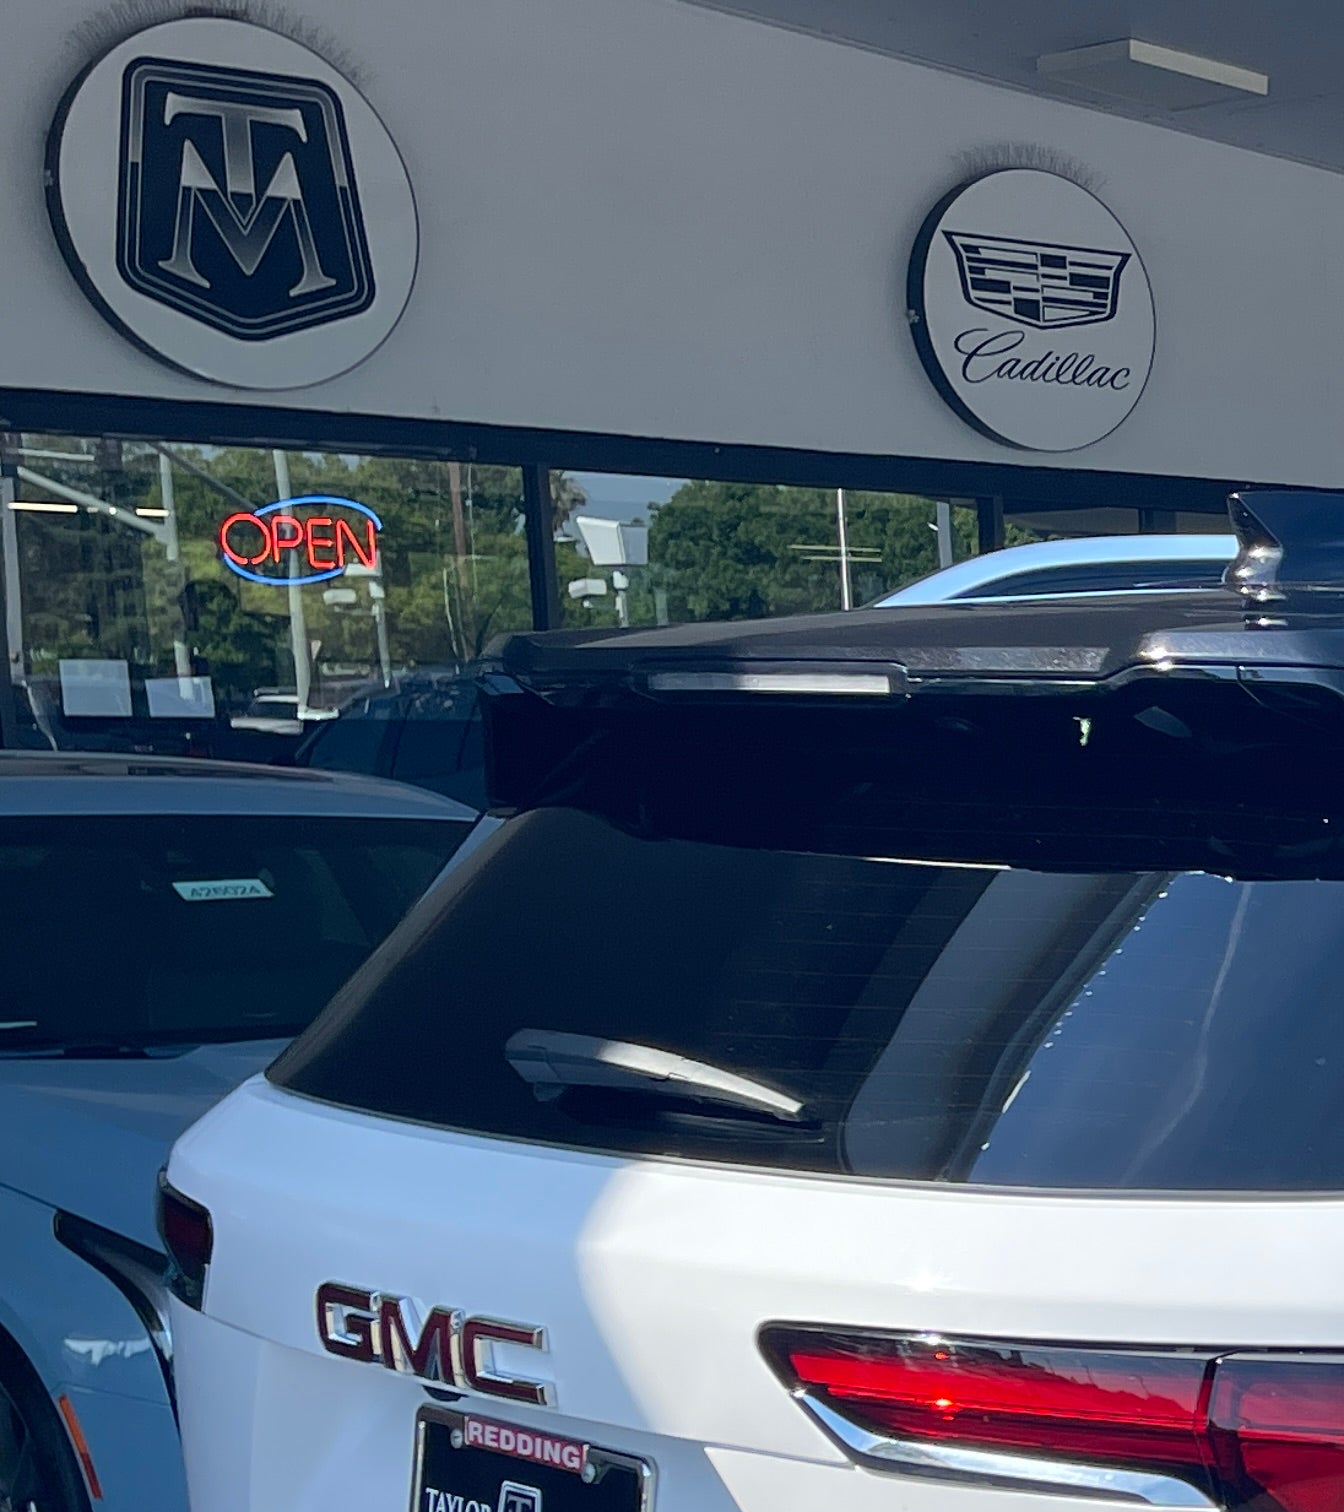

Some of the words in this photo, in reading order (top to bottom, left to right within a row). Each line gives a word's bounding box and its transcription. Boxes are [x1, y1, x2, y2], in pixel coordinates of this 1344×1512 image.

[953, 328, 1131, 391] Cadillac
[220, 511, 381, 571] OPEN
[316, 1279, 557, 1407] GMC
[467, 1419, 581, 1469] REDDING
